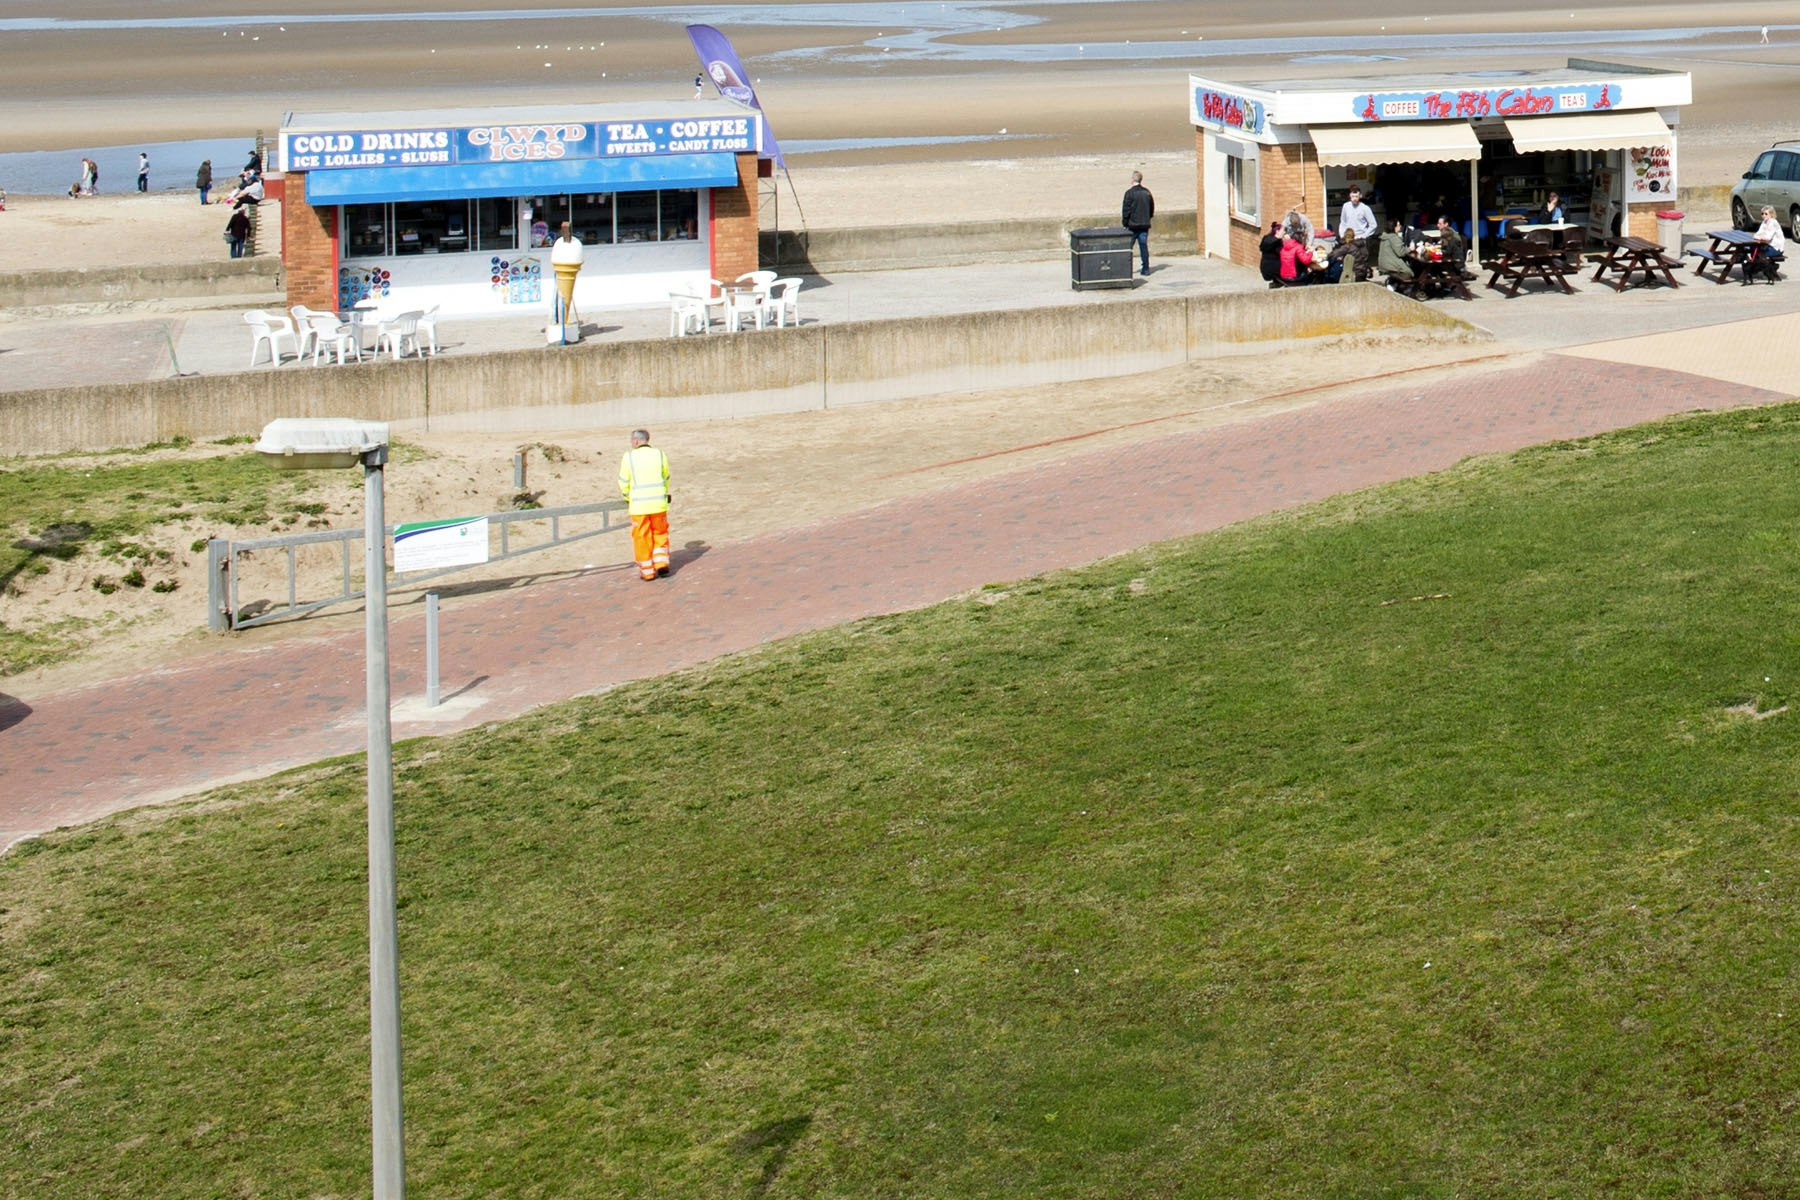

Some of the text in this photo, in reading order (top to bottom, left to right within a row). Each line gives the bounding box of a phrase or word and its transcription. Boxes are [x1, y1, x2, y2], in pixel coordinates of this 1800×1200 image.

[1384, 102, 1417, 115] COFFEE
[1423, 88, 1555, 118] The Fish Cabin
[1561, 94, 1585, 108] TEA'S
[468, 124, 587, 145] CLWYD
[607, 119, 748, 141] TEA COFFEE
[294, 132, 449, 153] COLD DRINKS
[490, 142, 565, 160] ICES
[607, 141, 656, 154] SWEETS
[669, 140, 710, 151] CANDY
[712, 138, 748, 150] FLOSS
[294, 156, 320, 167] ICE
[325, 153, 385, 166] LOLLIES
[401, 151, 449, 163] SLUSH
